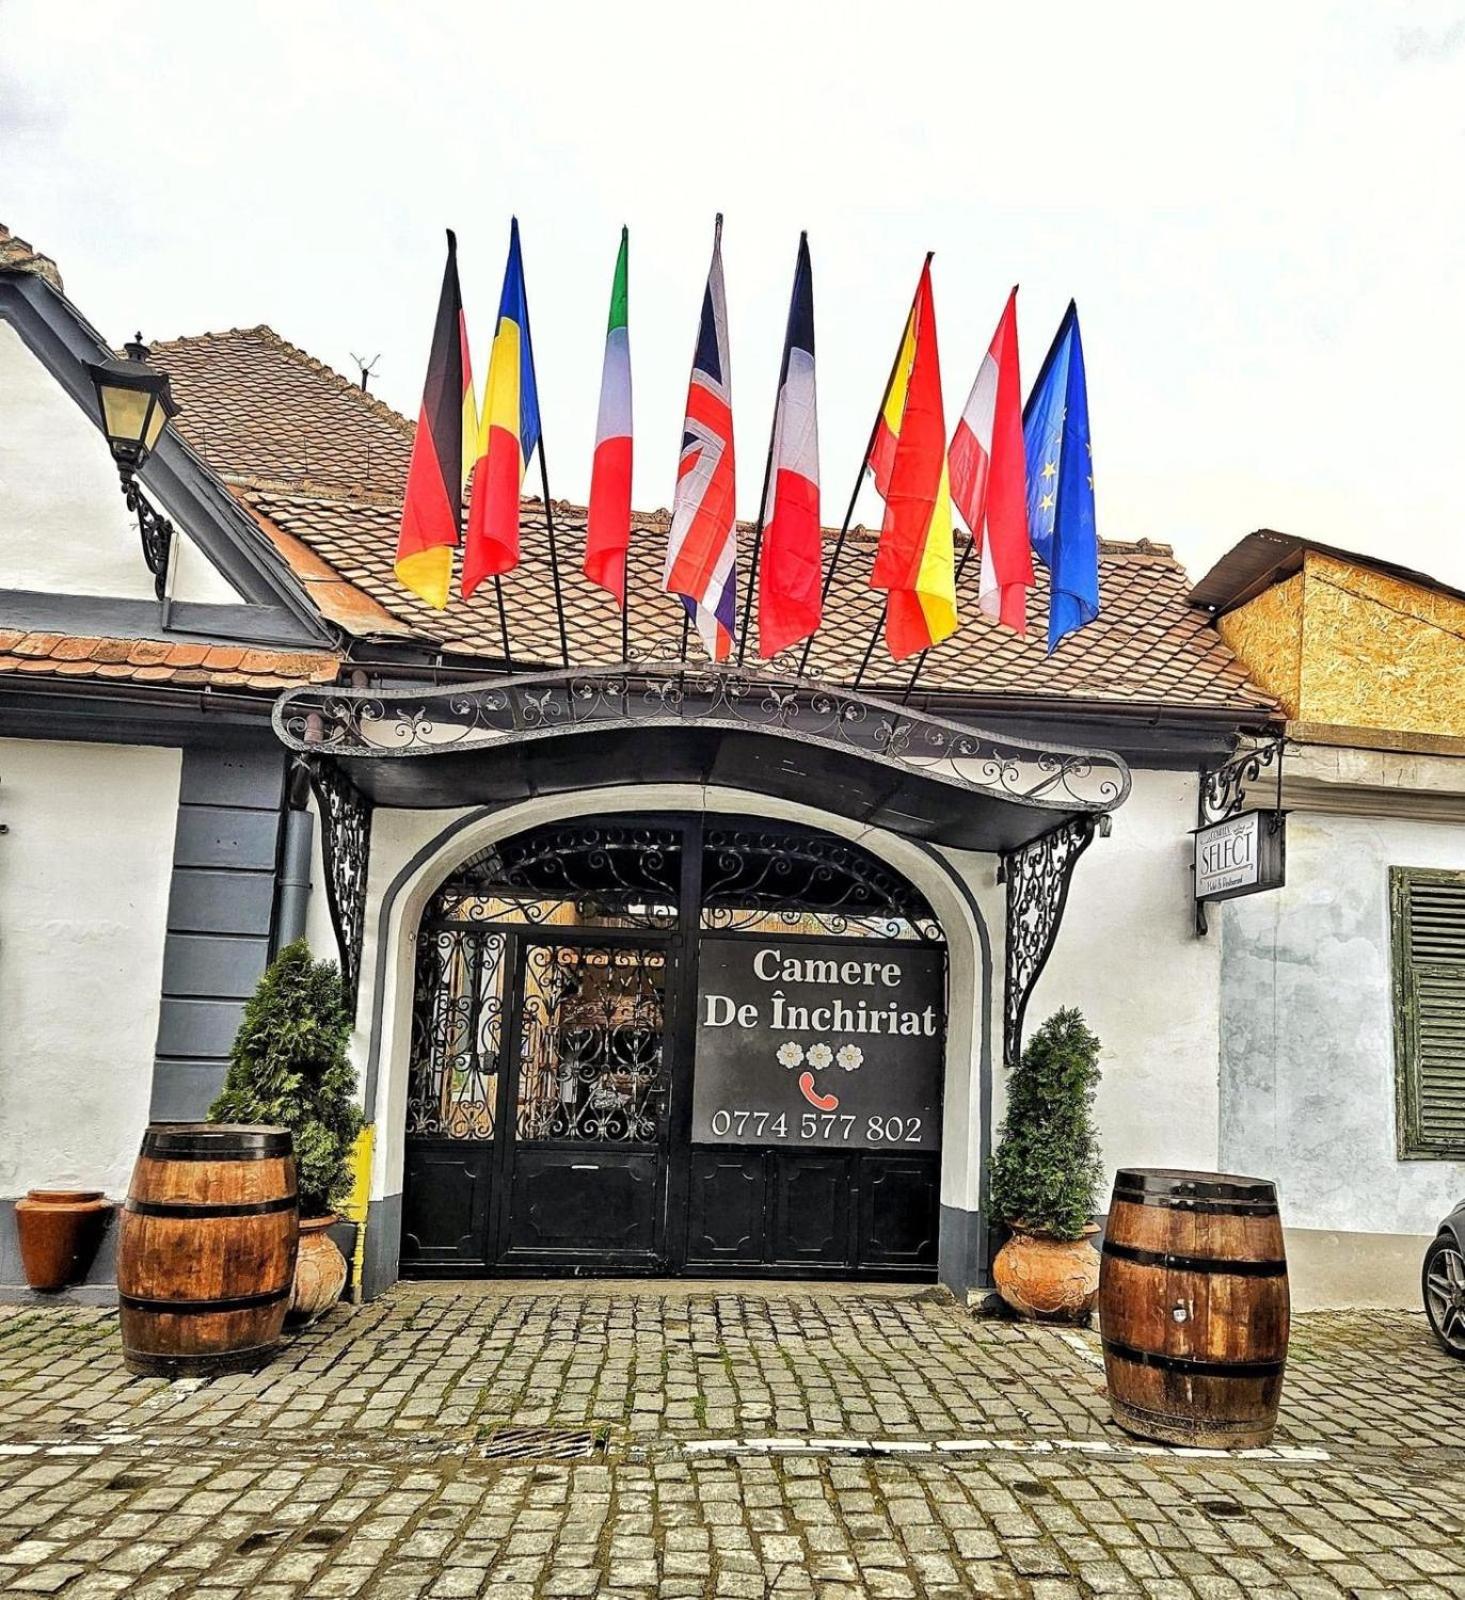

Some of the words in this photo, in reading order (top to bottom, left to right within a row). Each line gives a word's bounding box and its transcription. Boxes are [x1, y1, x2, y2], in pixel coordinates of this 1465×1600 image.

[1201, 831, 1253, 875] SELECT
[753, 949, 902, 987] Camere
[703, 994, 758, 1028] De
[770, 990, 937, 1036] Închiriat
[711, 1110, 788, 1138] 0774
[800, 1113, 856, 1140] 577
[866, 1115, 922, 1143] 802
